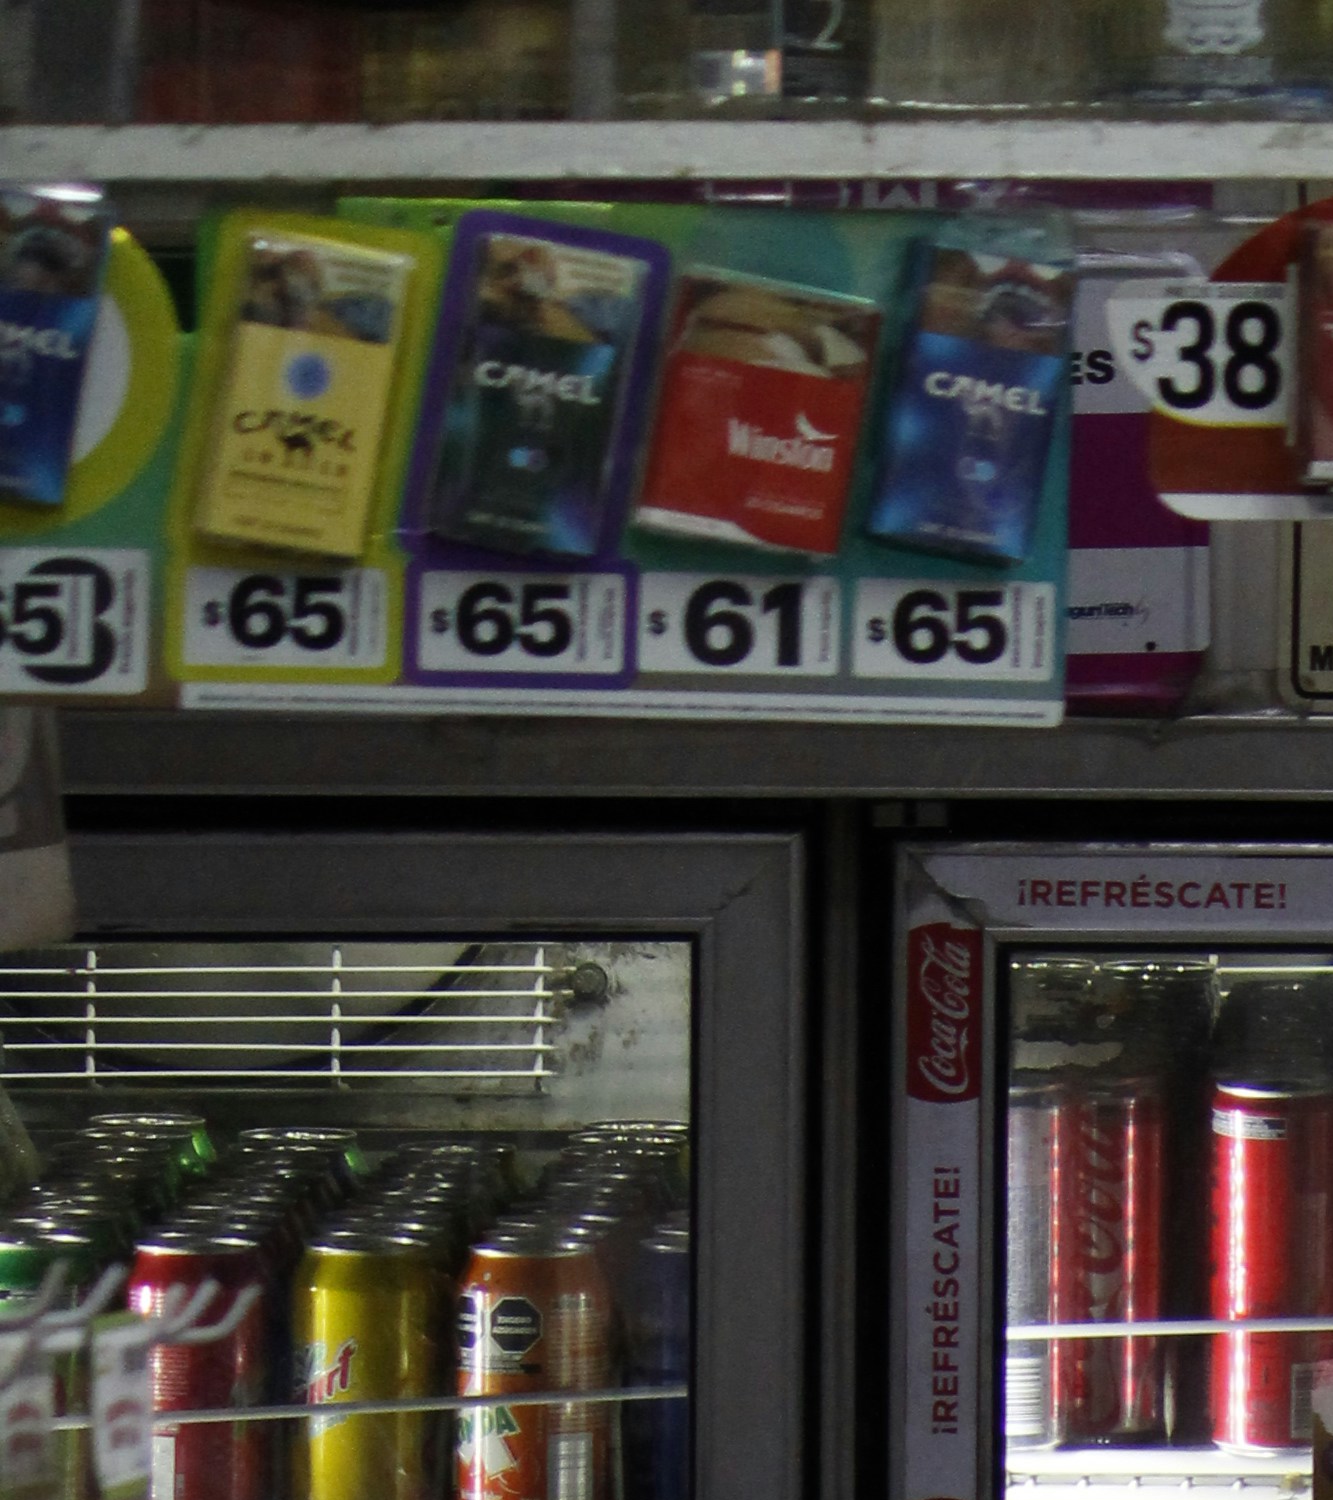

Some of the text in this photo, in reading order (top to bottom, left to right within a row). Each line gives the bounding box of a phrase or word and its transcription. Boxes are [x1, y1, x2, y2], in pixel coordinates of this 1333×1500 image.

[925, 371, 1047, 414] CAMEL
[728, 419, 835, 473] Winston
[1017, 875, 1286, 912] ¡REFRÉSCATE!
[931, 1167, 961, 1434] ¡REFRÉSCATE!
